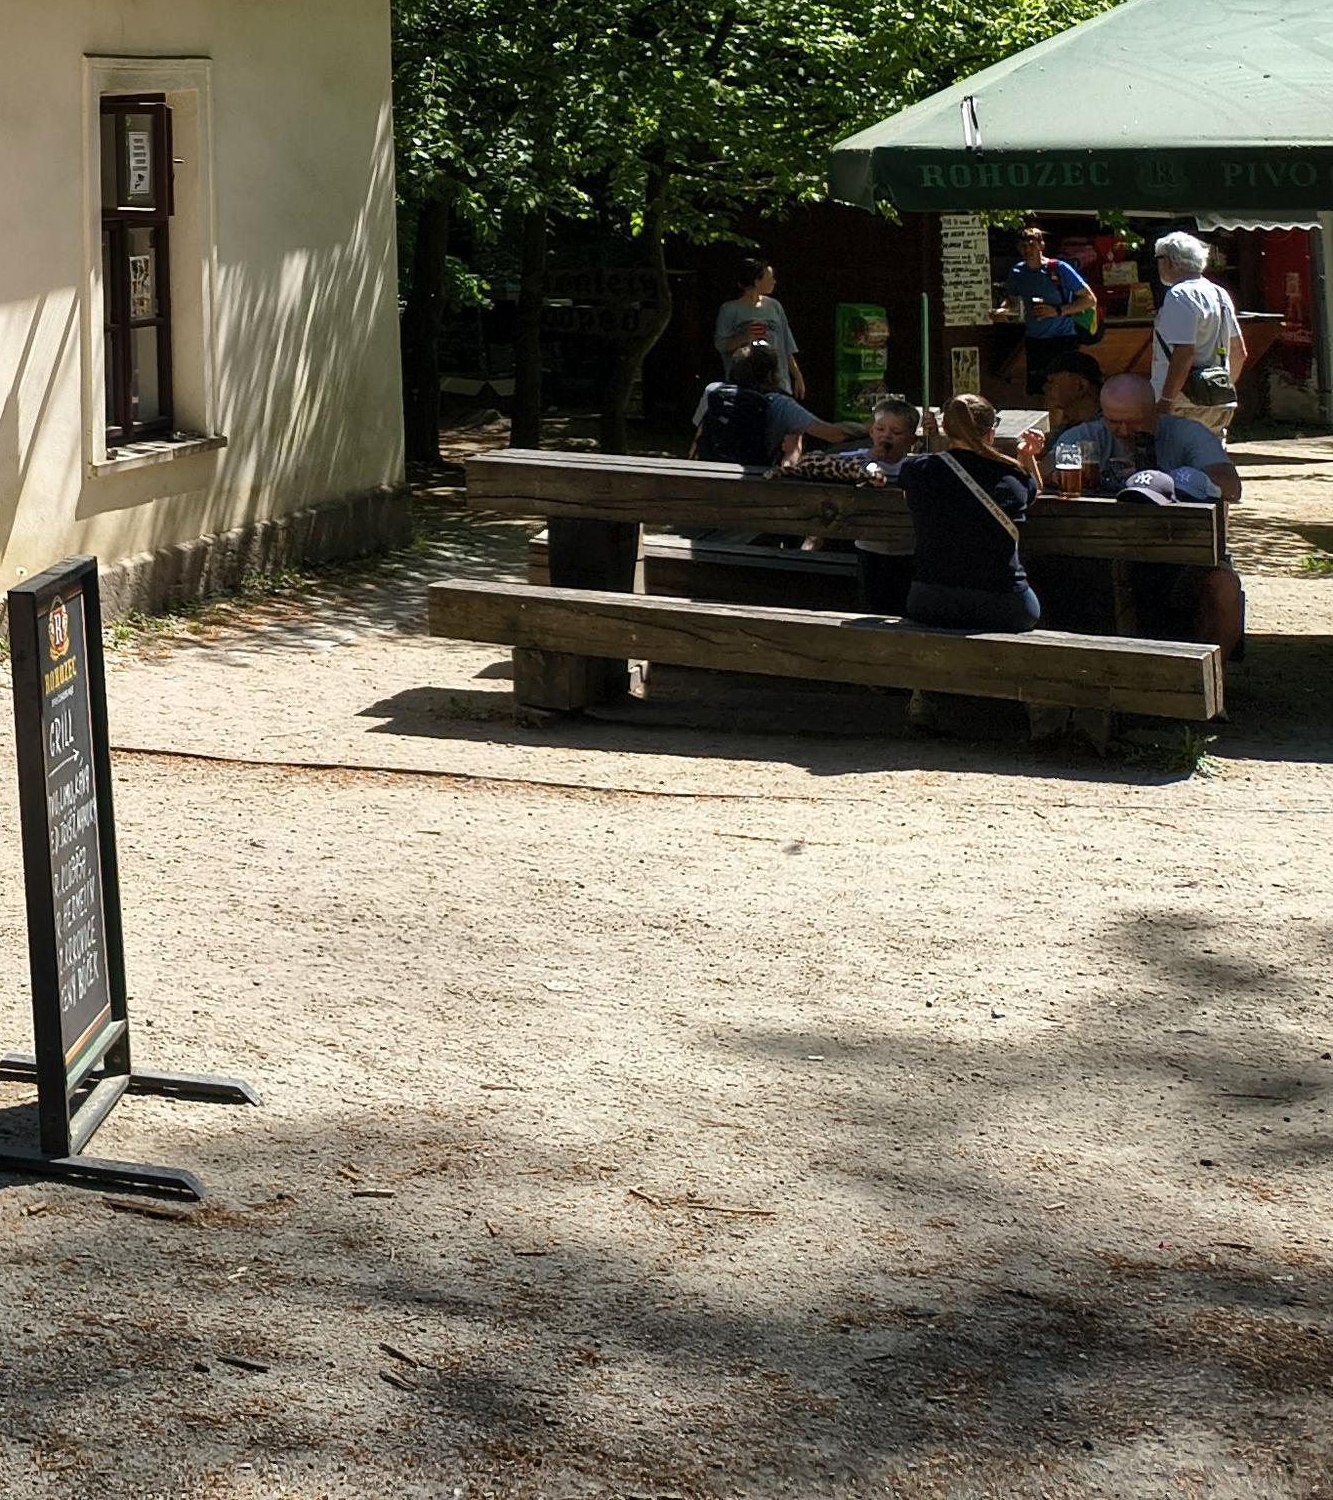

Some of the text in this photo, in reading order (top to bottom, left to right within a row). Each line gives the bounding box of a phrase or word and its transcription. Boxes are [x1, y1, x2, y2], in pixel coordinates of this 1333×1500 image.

[917, 161, 1111, 188] ROHOZEC
[1219, 161, 1318, 188] PIVO
[49, 708, 75, 757] GRILL
